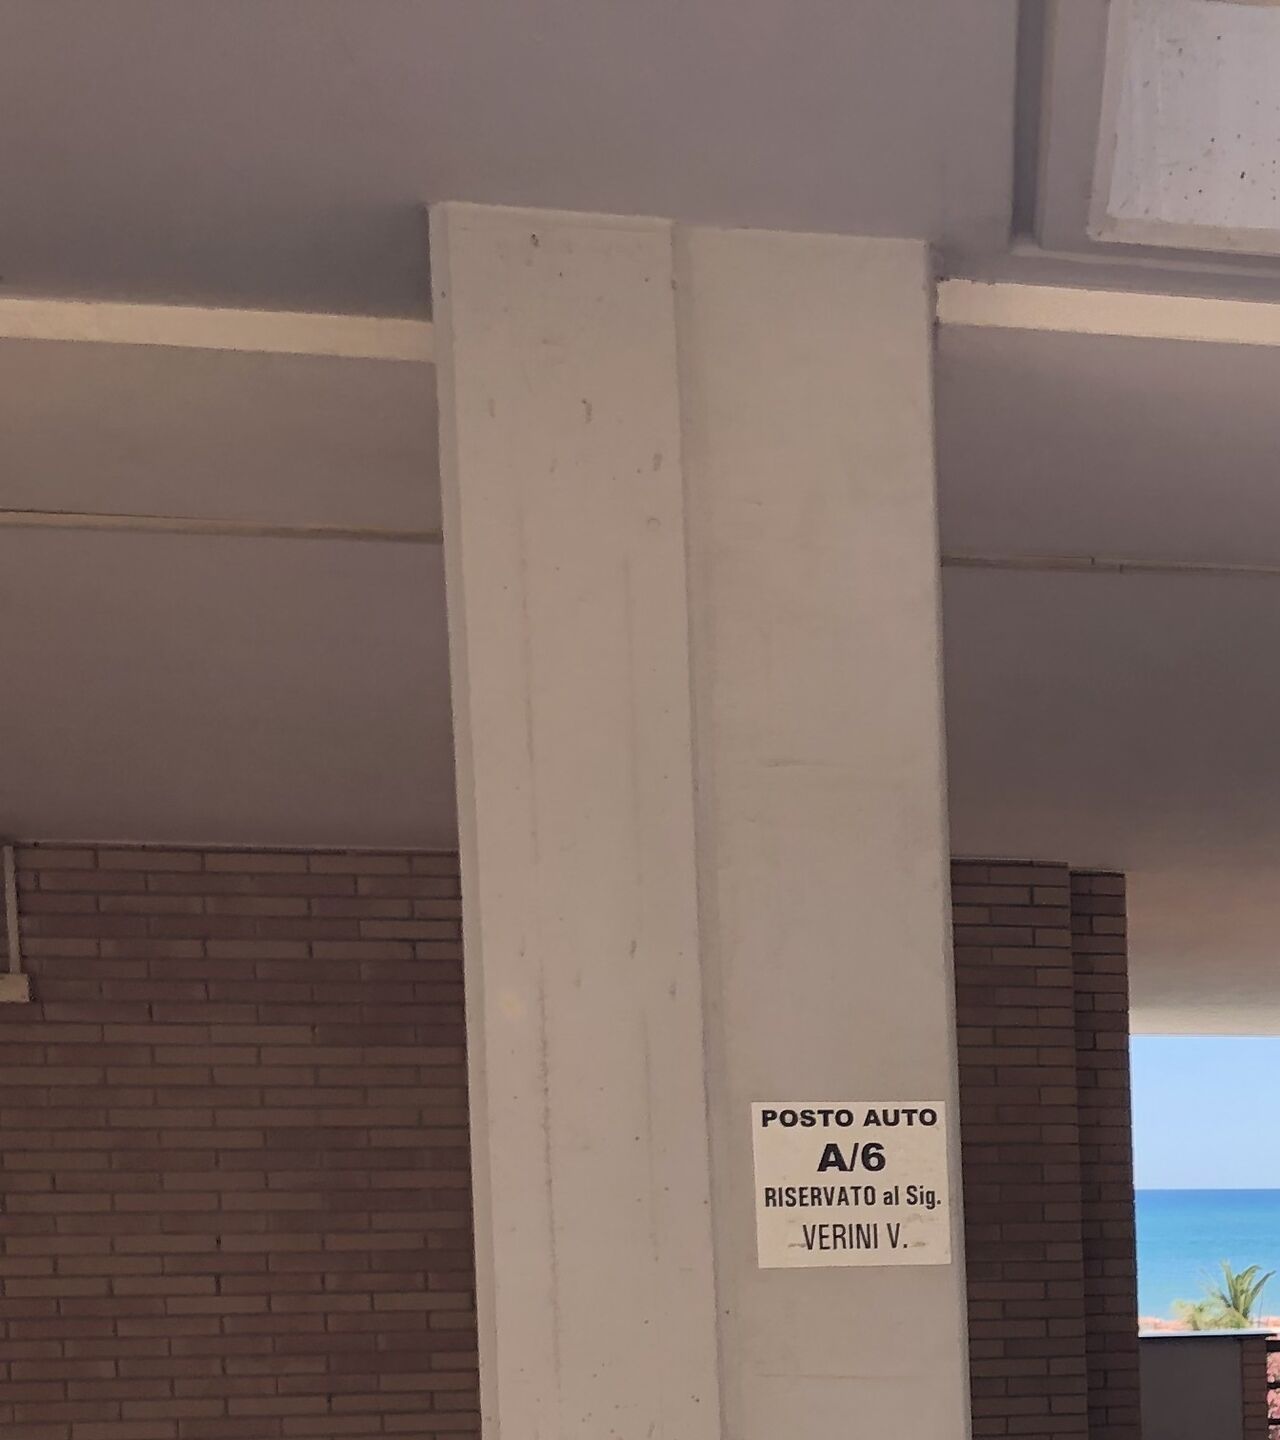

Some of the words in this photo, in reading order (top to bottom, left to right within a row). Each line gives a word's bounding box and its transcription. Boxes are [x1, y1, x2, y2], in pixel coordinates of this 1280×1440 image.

[761, 1109, 854, 1128] POSTO
[863, 1108, 937, 1127] AUTO
[816, 1142, 886, 1172] A/6
[764, 1185, 877, 1208] RISERVATO
[883, 1185, 899, 1206] al
[906, 1184, 942, 1210] Sig.
[802, 1223, 878, 1250] VERINI
[886, 1222, 908, 1249] V.
